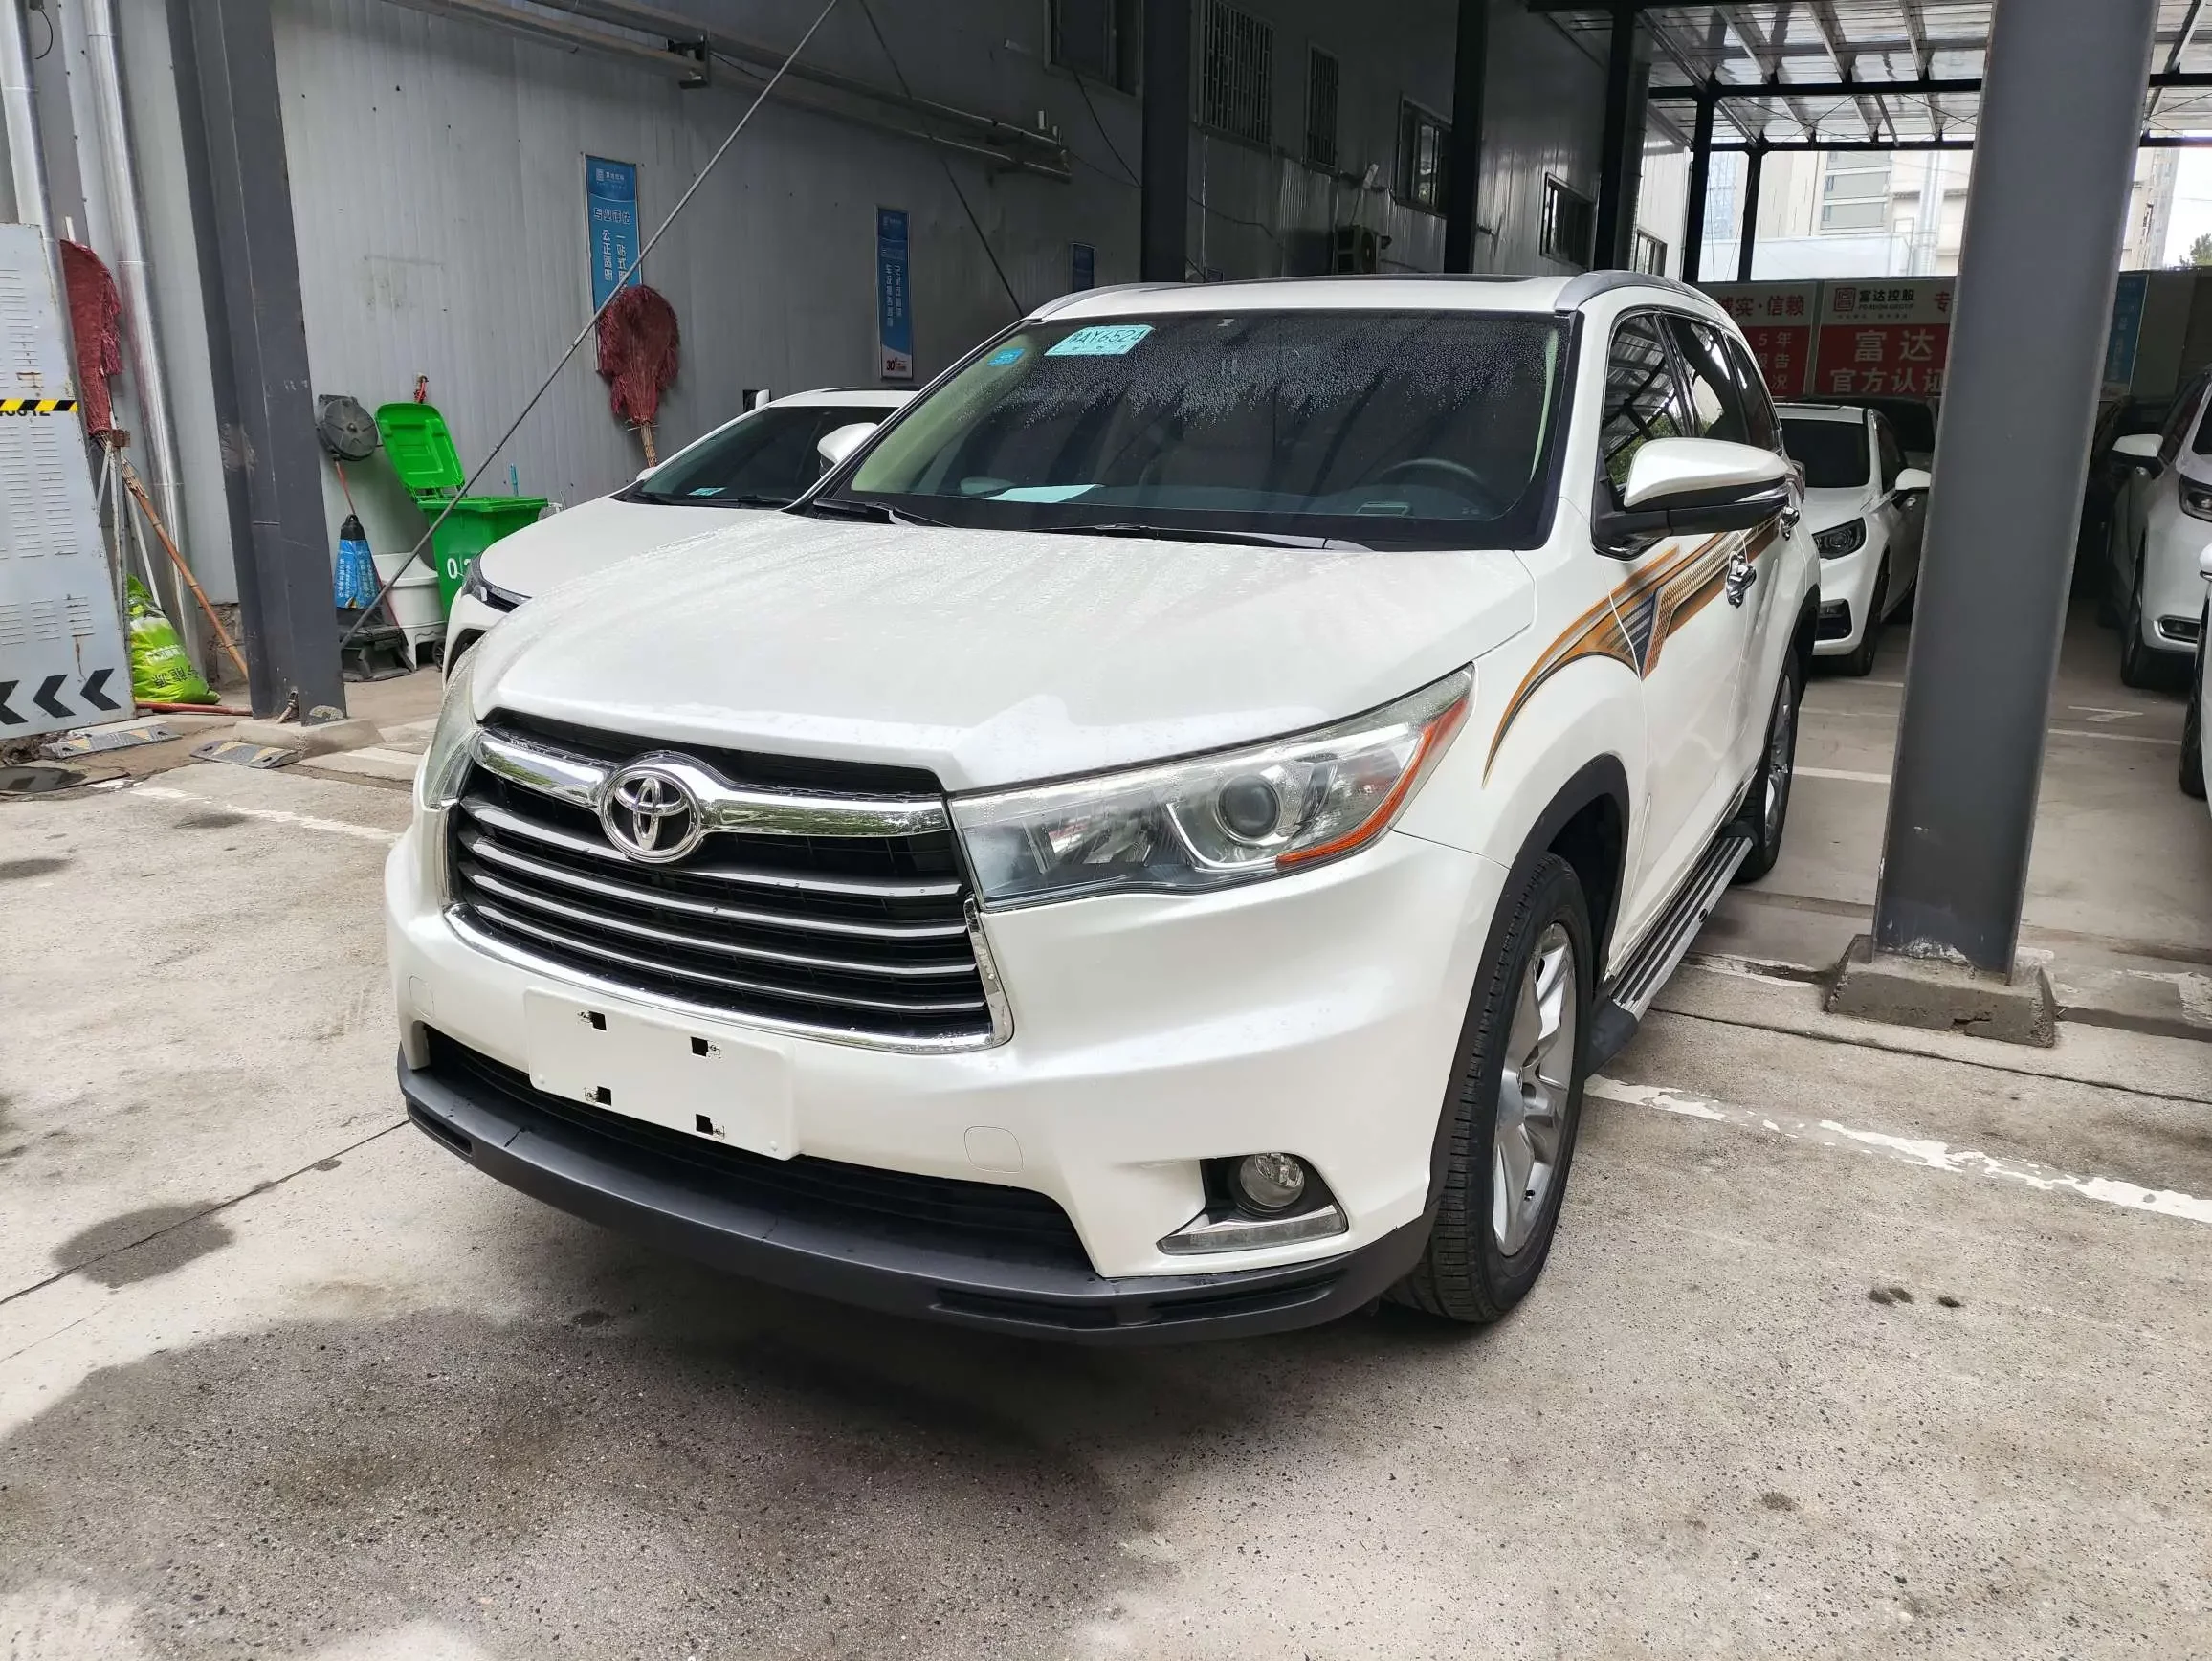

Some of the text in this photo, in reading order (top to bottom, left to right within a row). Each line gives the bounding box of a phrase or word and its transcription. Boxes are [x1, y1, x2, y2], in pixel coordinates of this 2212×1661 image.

[601, 229, 613, 282] 公正透明
[1859, 288, 1914, 302] 富达控股
[1854, 328, 1936, 363] 富达
[1829, 367, 1946, 393] 官方认证
